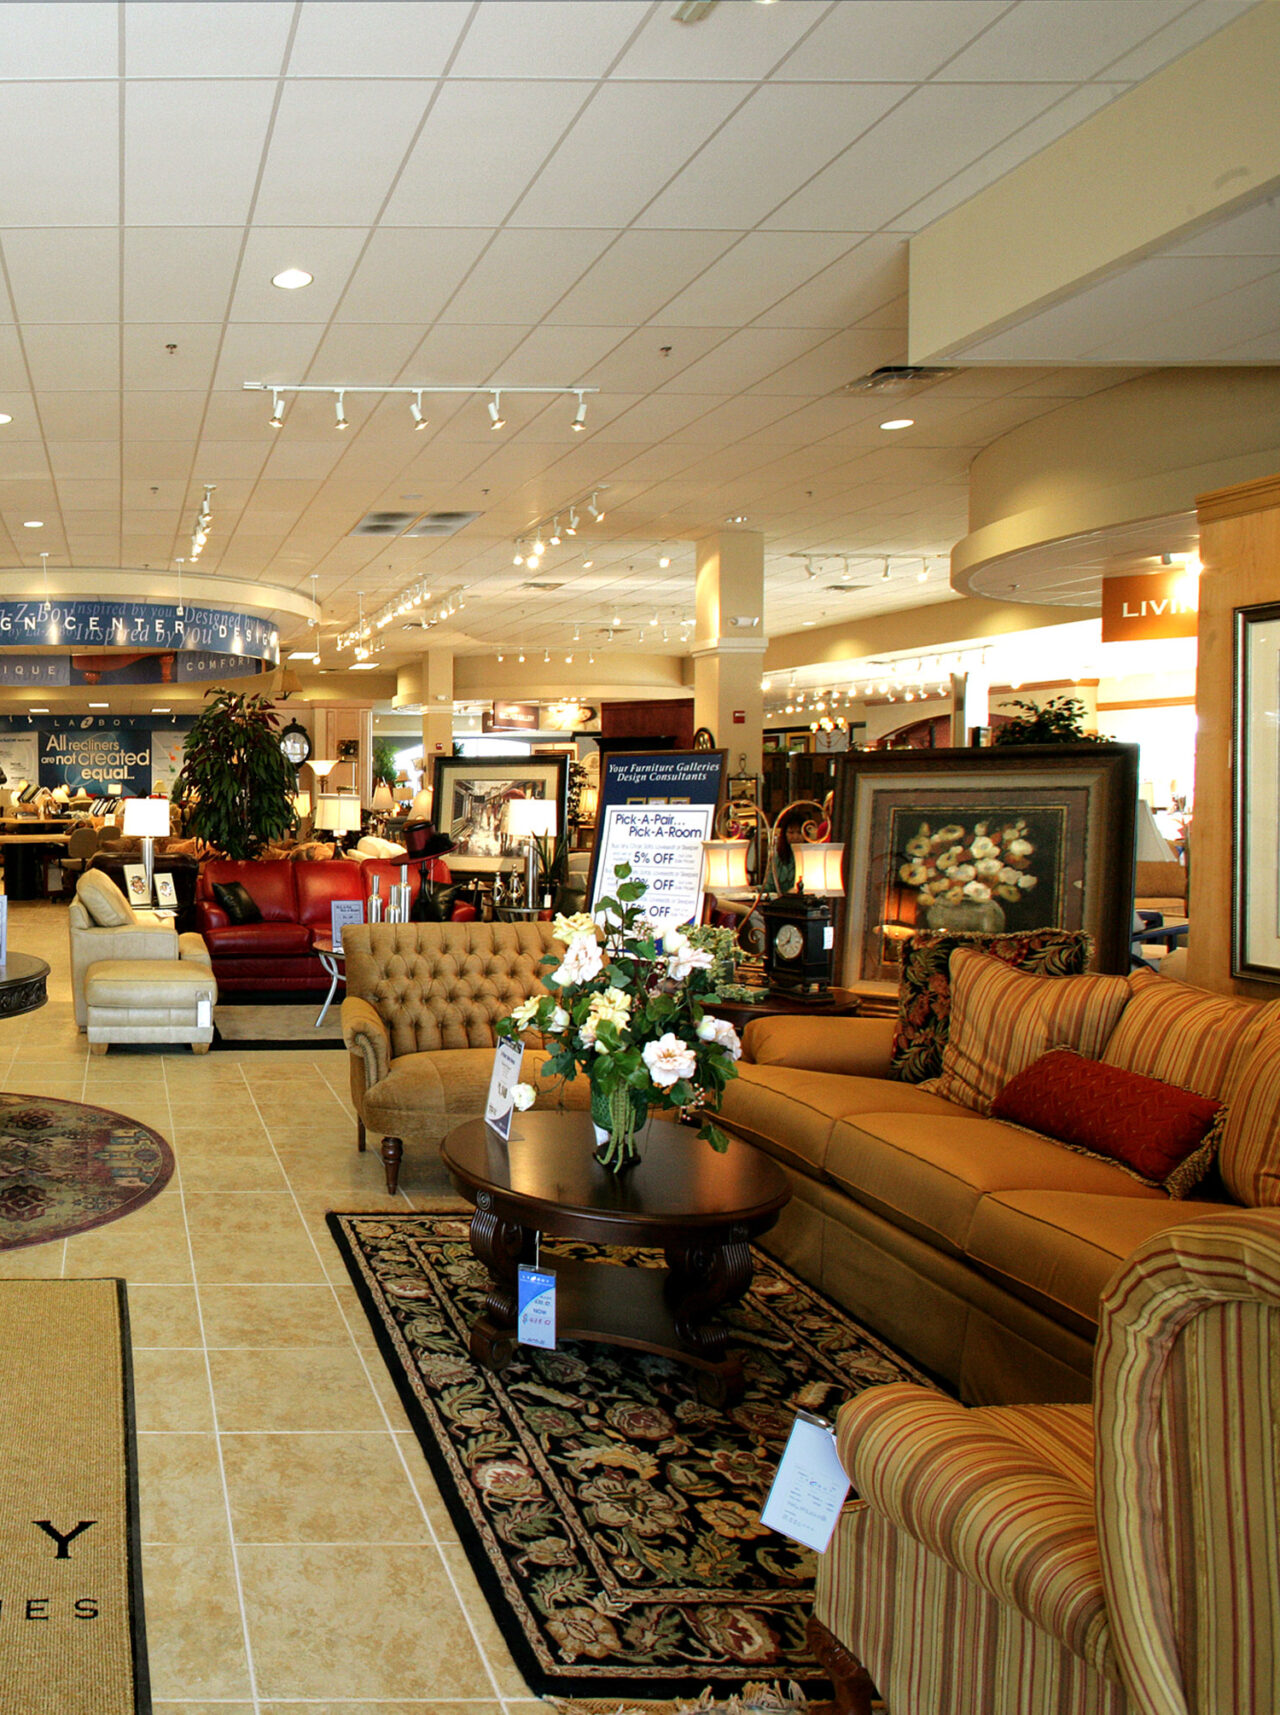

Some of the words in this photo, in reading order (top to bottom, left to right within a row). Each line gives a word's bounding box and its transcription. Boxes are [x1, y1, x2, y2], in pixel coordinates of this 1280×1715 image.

[64, 616, 185, 634] CENTER
[219, 625, 276, 646] DESIG
[46, 734, 67, 751] All
[68, 739, 120, 751] recliners
[55, 752, 77, 765] not
[77, 749, 150, 766] created
[608, 764, 629, 773] Your
[629, 763, 674, 773] Furniture
[676, 761, 720, 772] Galleries
[617, 773, 647, 784] Design
[649, 772, 708, 782] Consultants
[629, 826, 702, 838] Pick-A-Room
[633, 851, 650, 864] 5%
[653, 853, 675, 864] OFF
[653, 879, 674, 890] OFF
[649, 905, 671, 917] OFF
